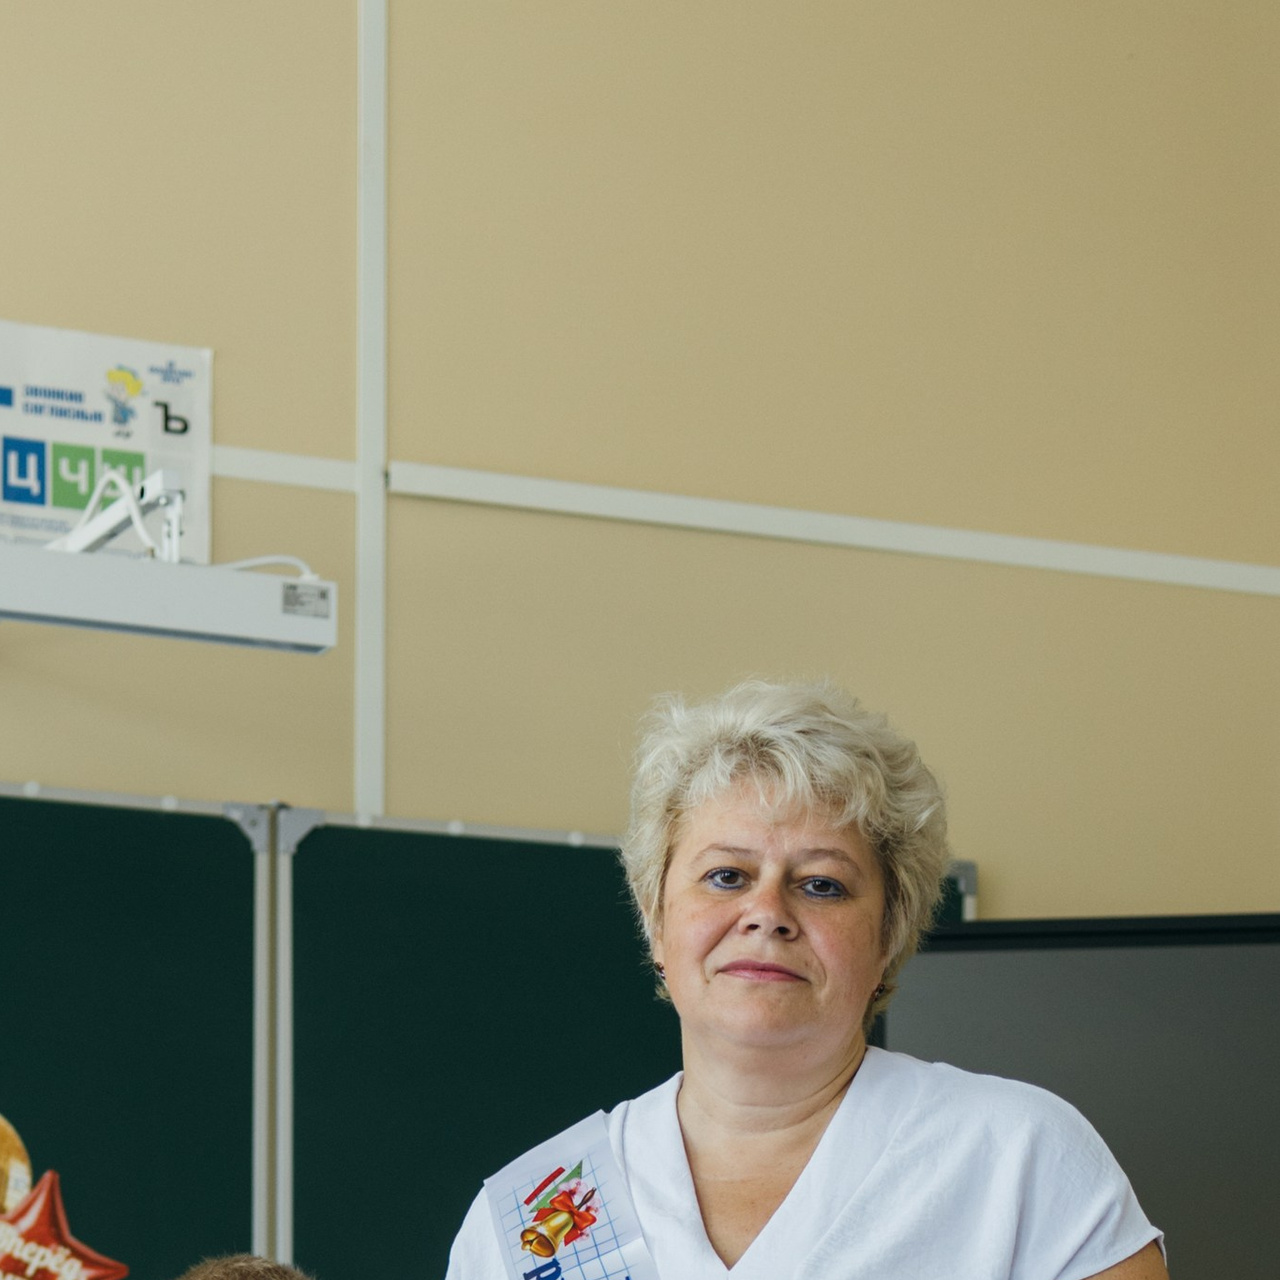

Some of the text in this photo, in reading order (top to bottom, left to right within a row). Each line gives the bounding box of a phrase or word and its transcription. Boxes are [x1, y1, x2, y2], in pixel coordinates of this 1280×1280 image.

[153, 400, 190, 436] Ъ
[6, 450, 42, 496] Ц
[57, 455, 91, 496] Ч
